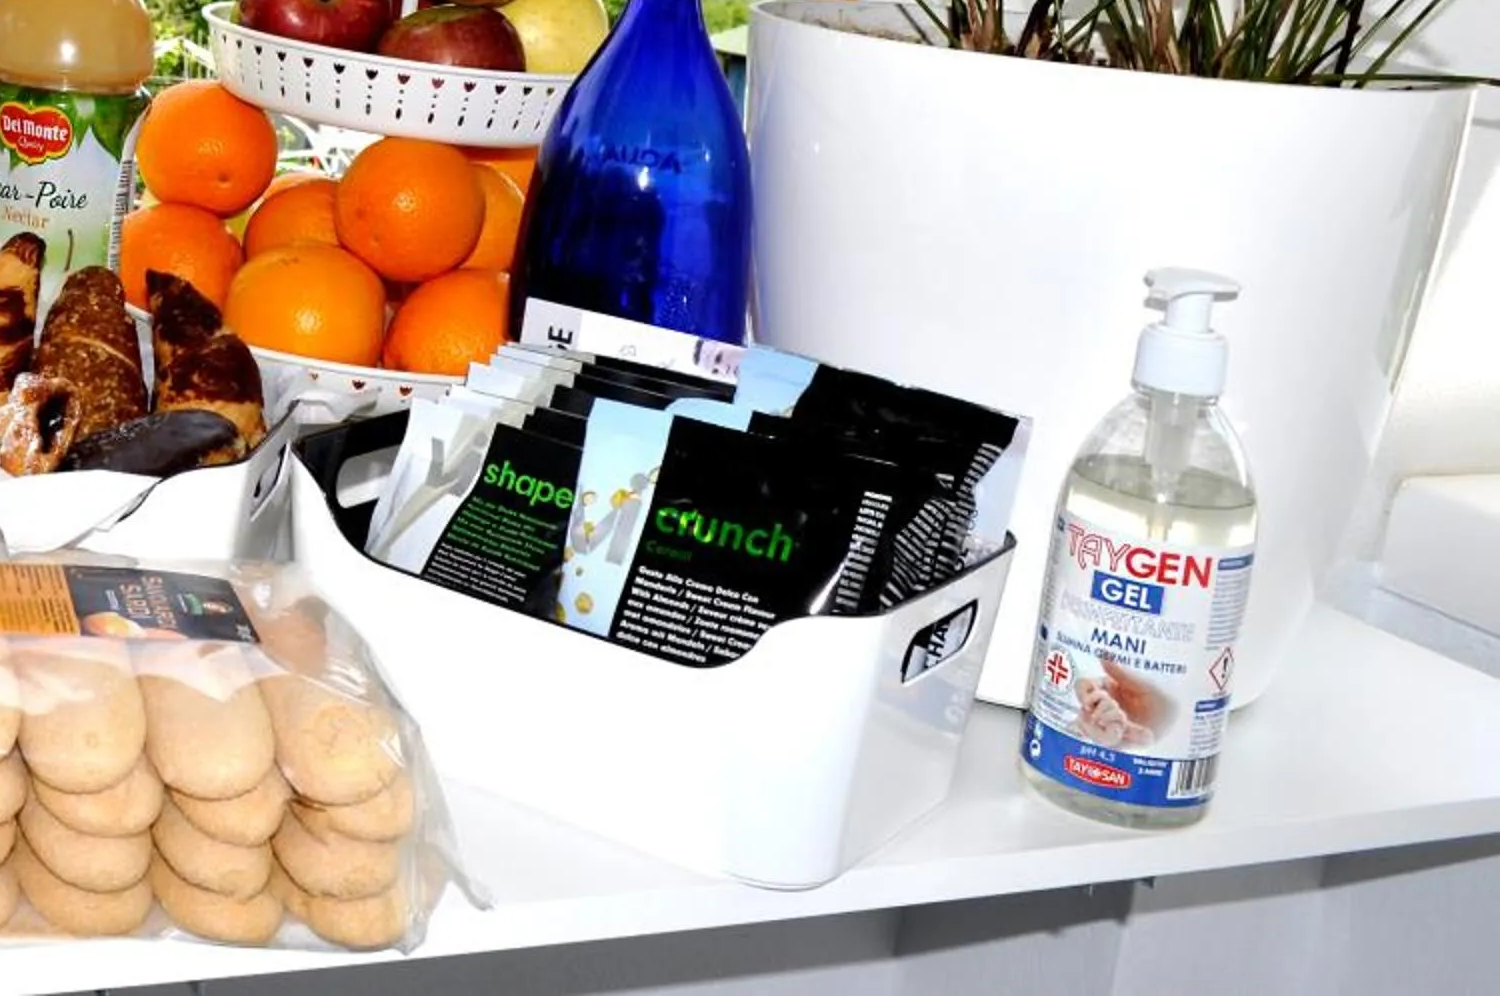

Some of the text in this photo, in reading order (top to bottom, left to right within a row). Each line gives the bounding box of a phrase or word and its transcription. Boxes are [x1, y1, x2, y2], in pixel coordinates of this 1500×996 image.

[2, 115, 69, 142] Del Monte
[3, 205, 50, 229] Nectar
[484, 460, 574, 509] shape
[656, 507, 794, 562] crunch
[1067, 522, 1214, 589] TAYGEN
[1101, 578, 1154, 610] GEL
[1090, 627, 1148, 656] MANI
[1133, 656, 1143, 670] E
[1143, 659, 1188, 676] BATTERI
